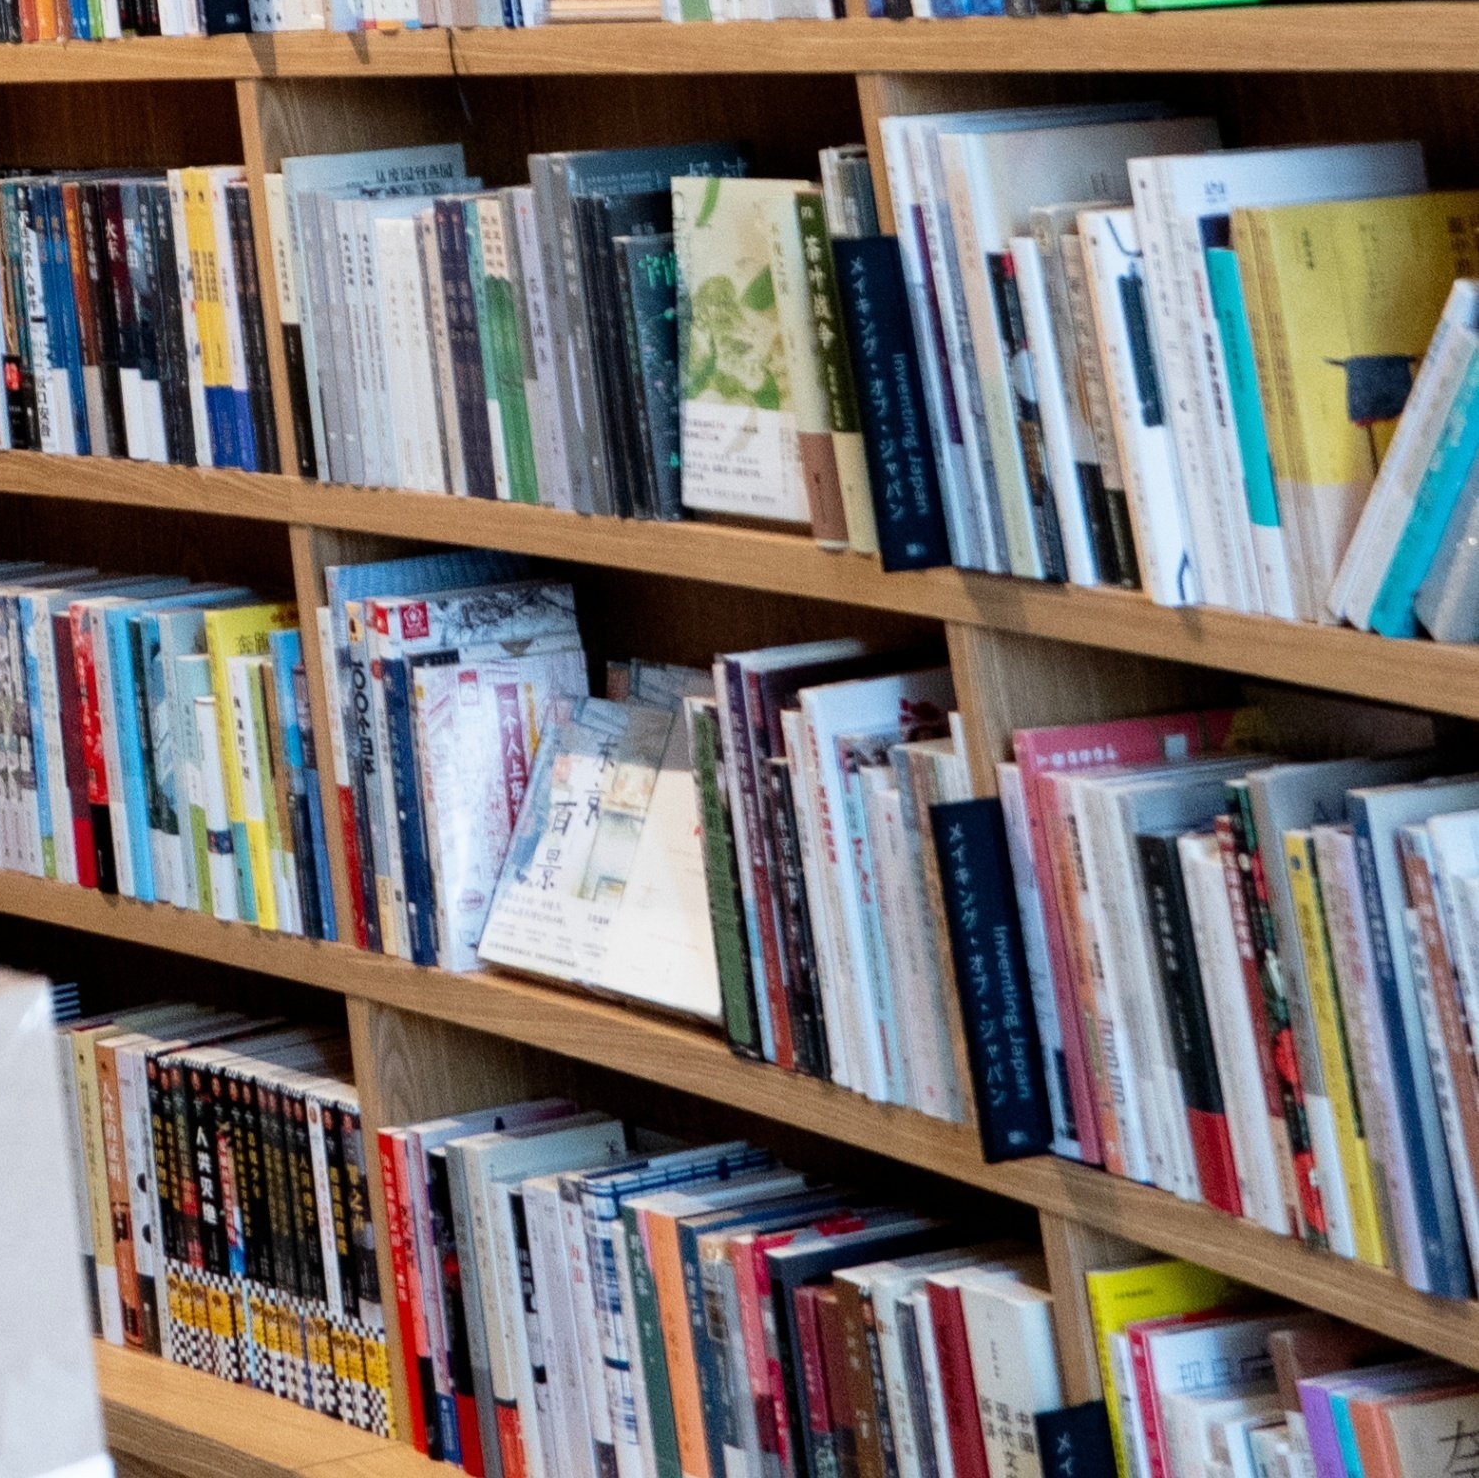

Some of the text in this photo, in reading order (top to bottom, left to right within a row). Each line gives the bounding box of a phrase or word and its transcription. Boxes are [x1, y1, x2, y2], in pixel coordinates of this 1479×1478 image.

[849, 254, 904, 522] メイキング・オブ・ジャパン
[891, 351, 931, 516] Inventing Japan
[534, 800, 578, 892] 百景
[948, 821, 1009, 1107] メイキング・オブ・ジャパン
[991, 924, 1033, 1100] Inventing Japan
[195, 1126, 219, 1227] 人类灭绝
